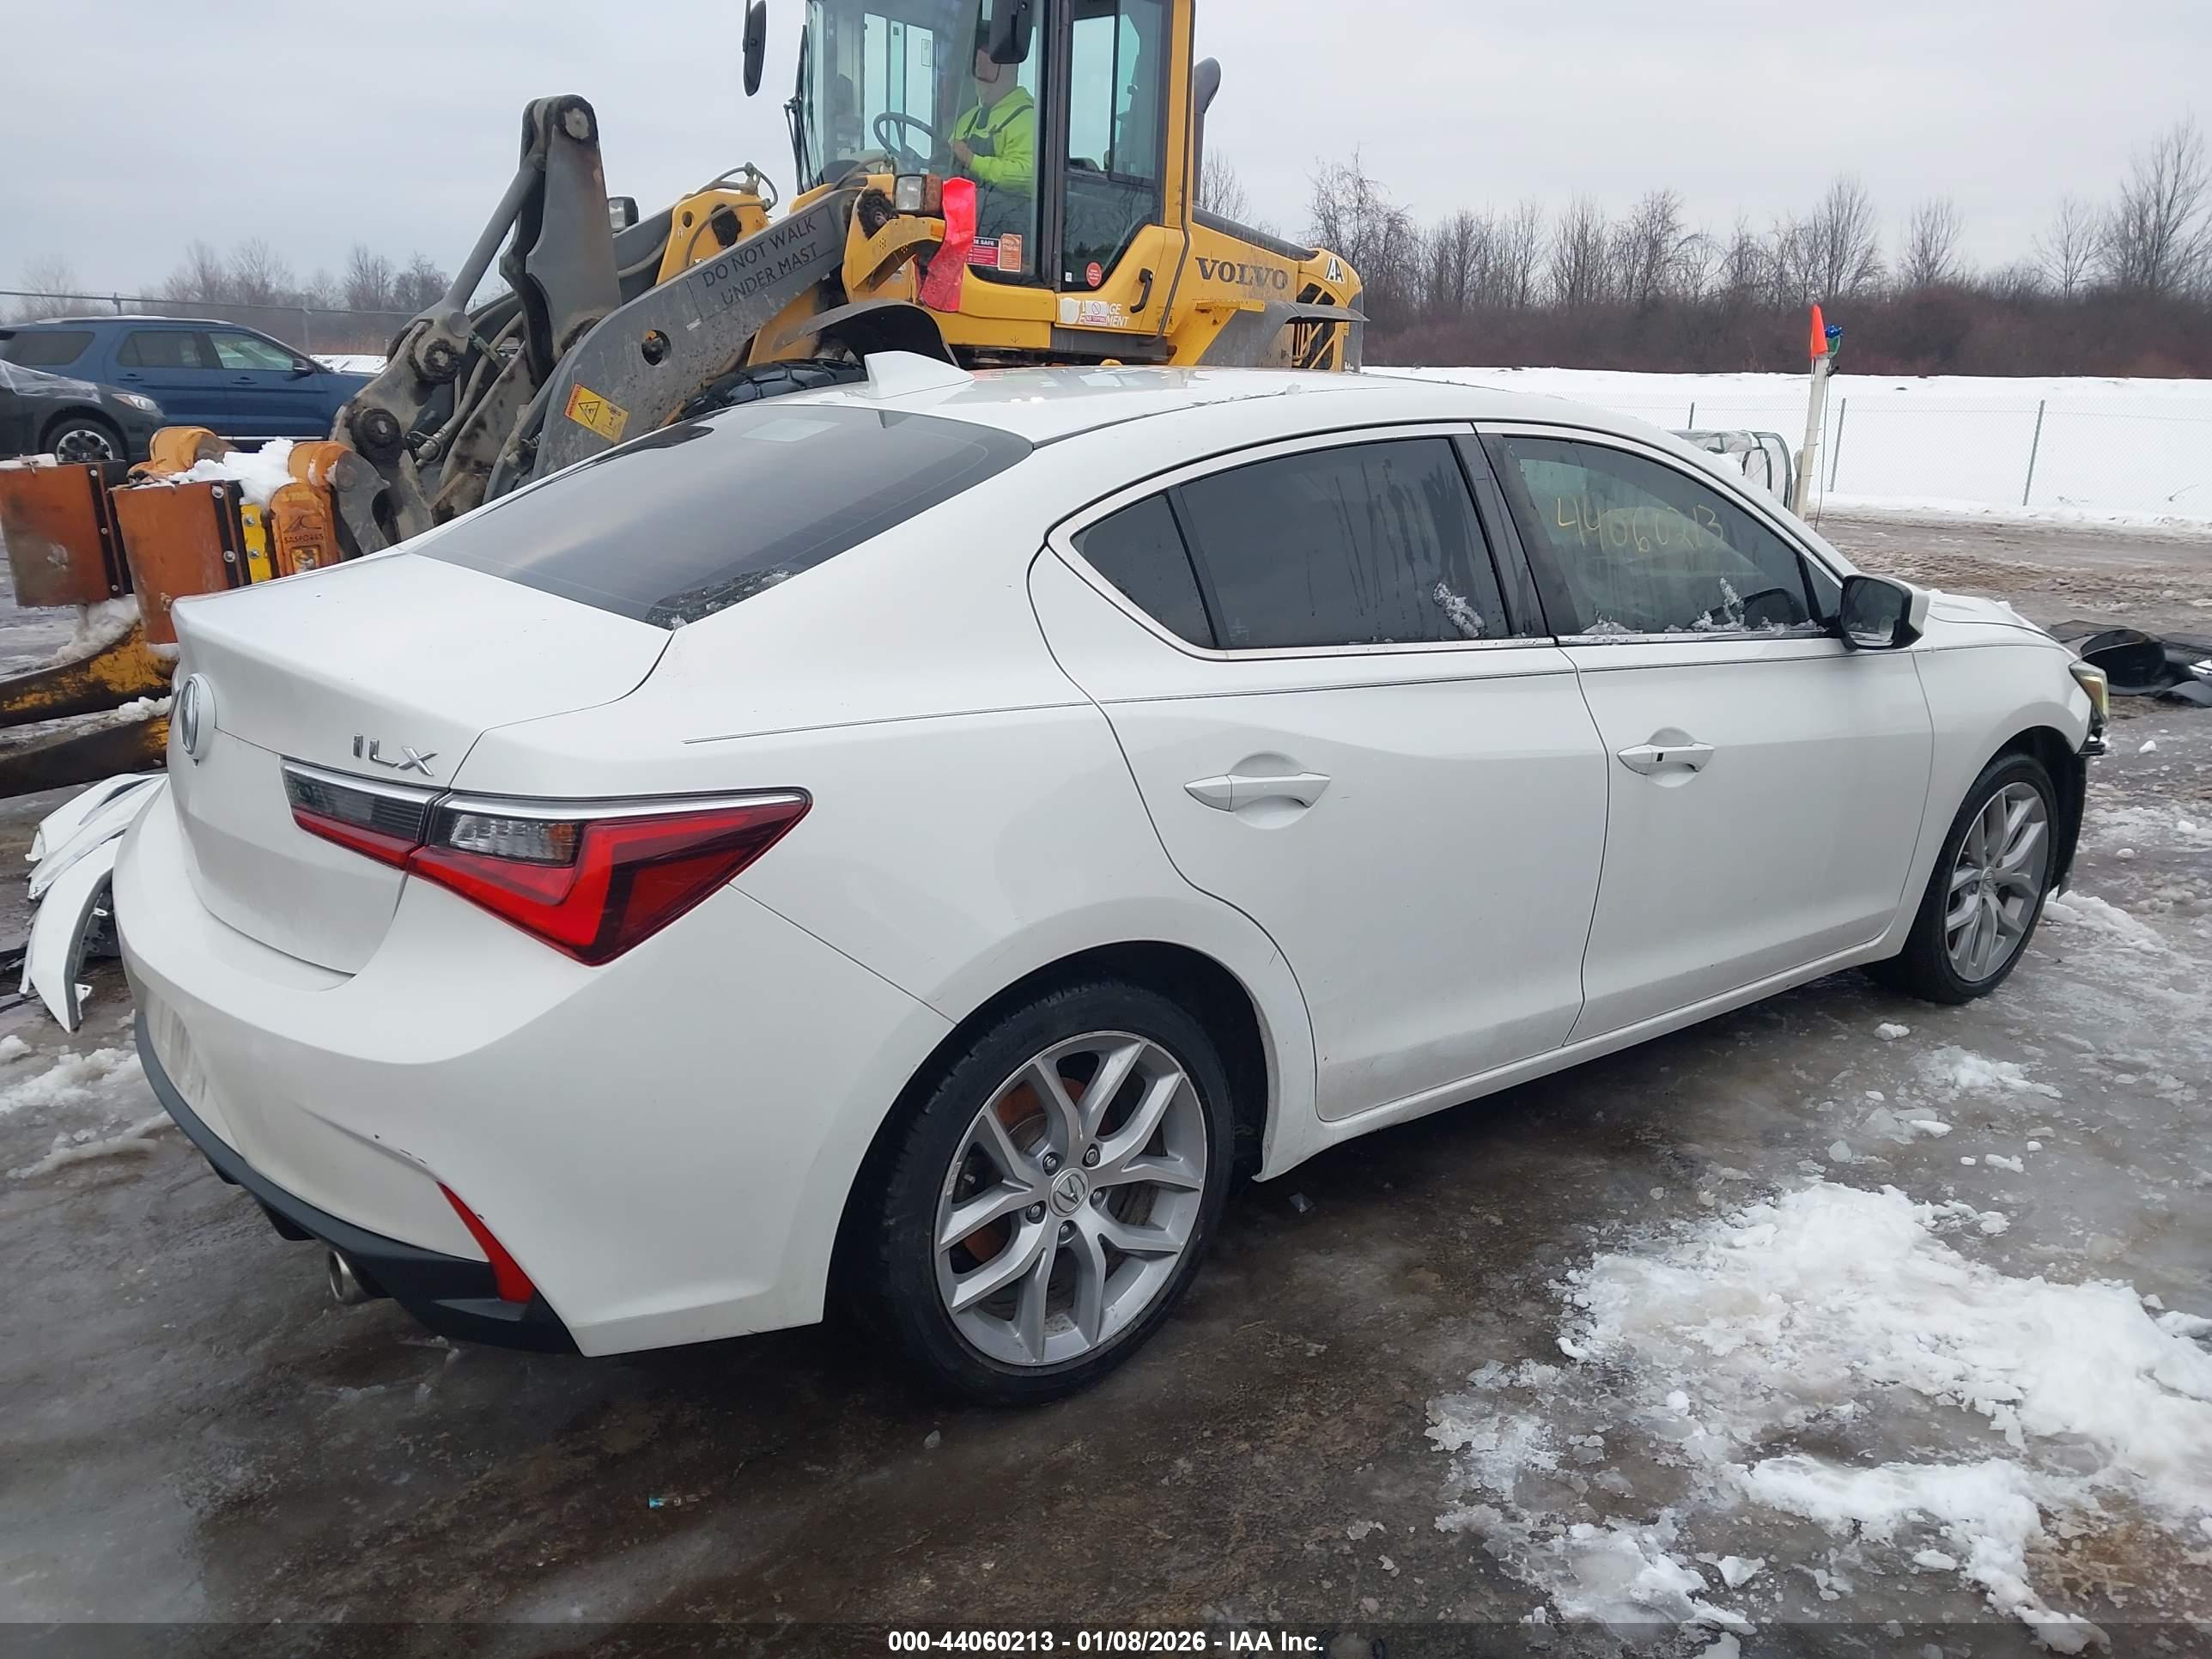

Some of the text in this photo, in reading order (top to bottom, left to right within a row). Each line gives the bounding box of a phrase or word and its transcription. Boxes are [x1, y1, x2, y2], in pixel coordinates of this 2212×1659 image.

[702, 216, 817, 288] DO NOT WALK
[721, 241, 818, 305] UNDER MAST
[1195, 257, 1288, 290] VOLVO
[352, 733, 438, 777] ILX
